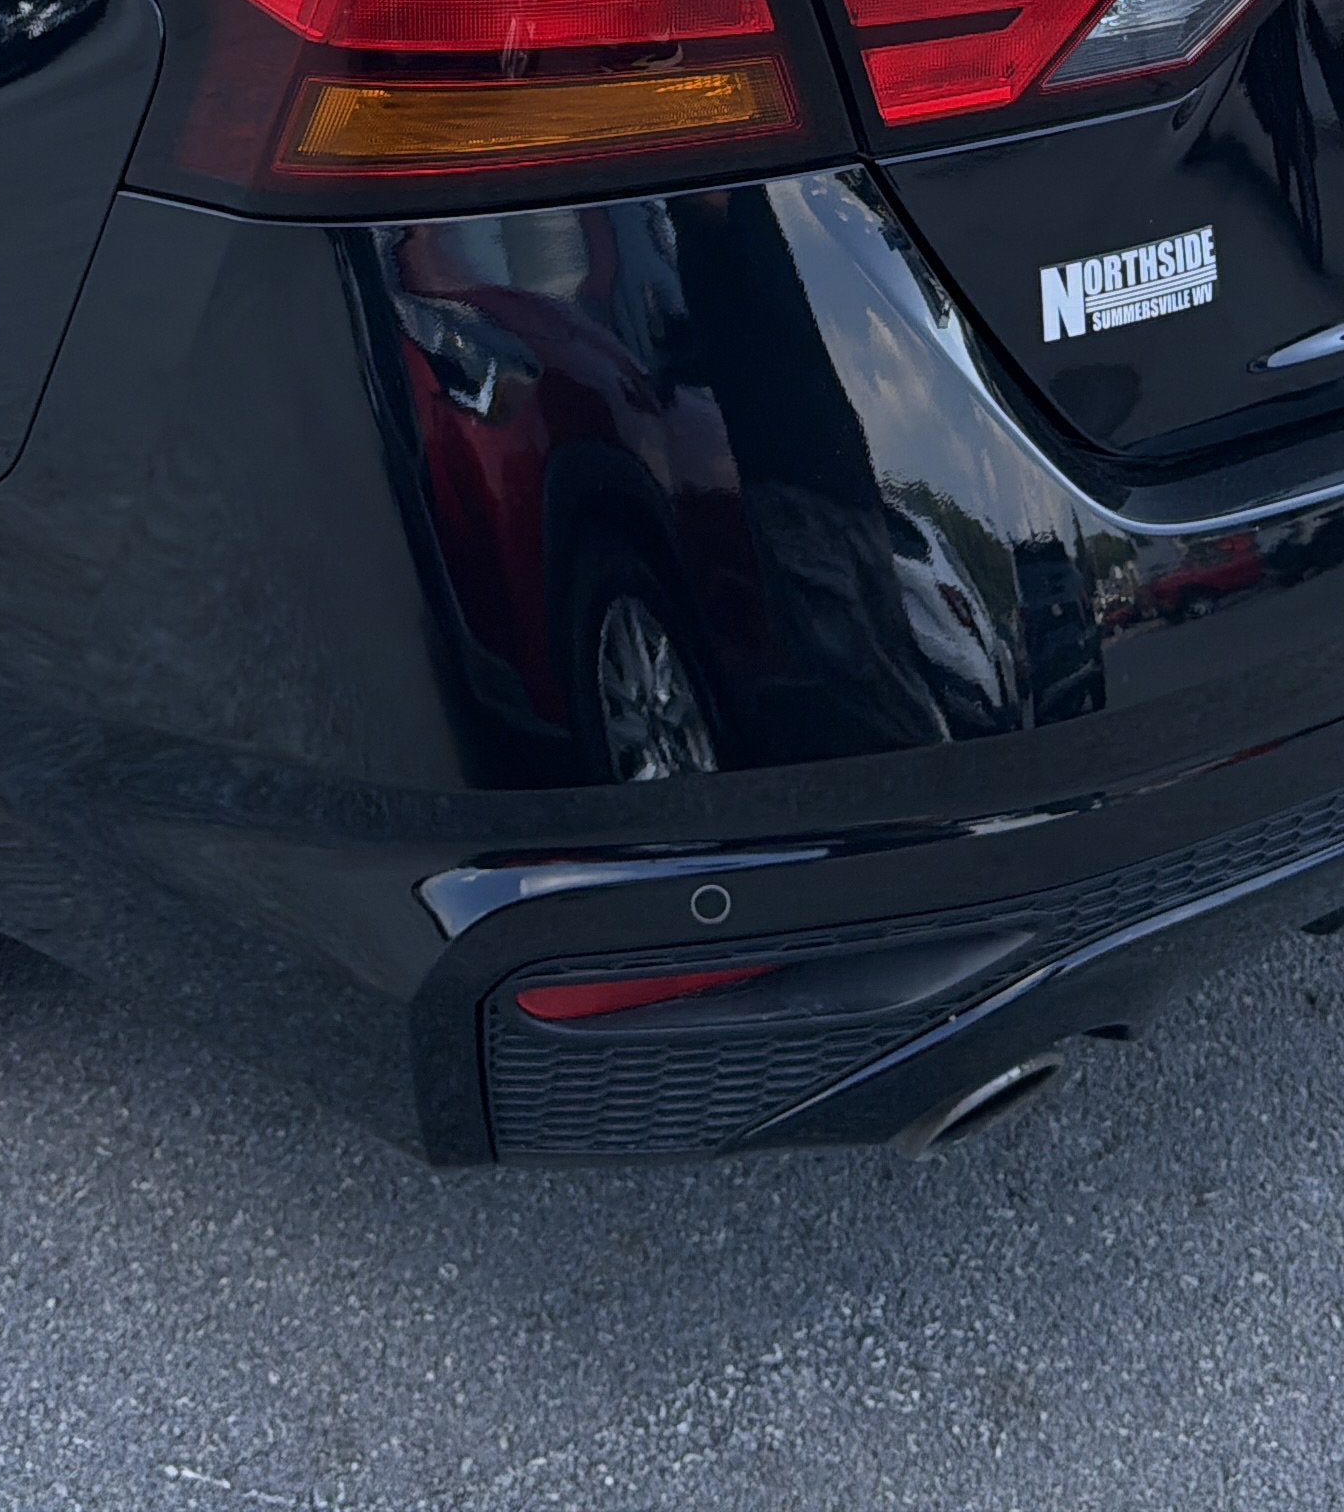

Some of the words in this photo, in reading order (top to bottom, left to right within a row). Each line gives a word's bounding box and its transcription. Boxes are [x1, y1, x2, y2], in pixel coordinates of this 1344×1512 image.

[1040, 227, 1217, 343] NORTHSIDE
[1092, 289, 1191, 332] SUMMERSVILLE
[1192, 282, 1214, 307] WV
